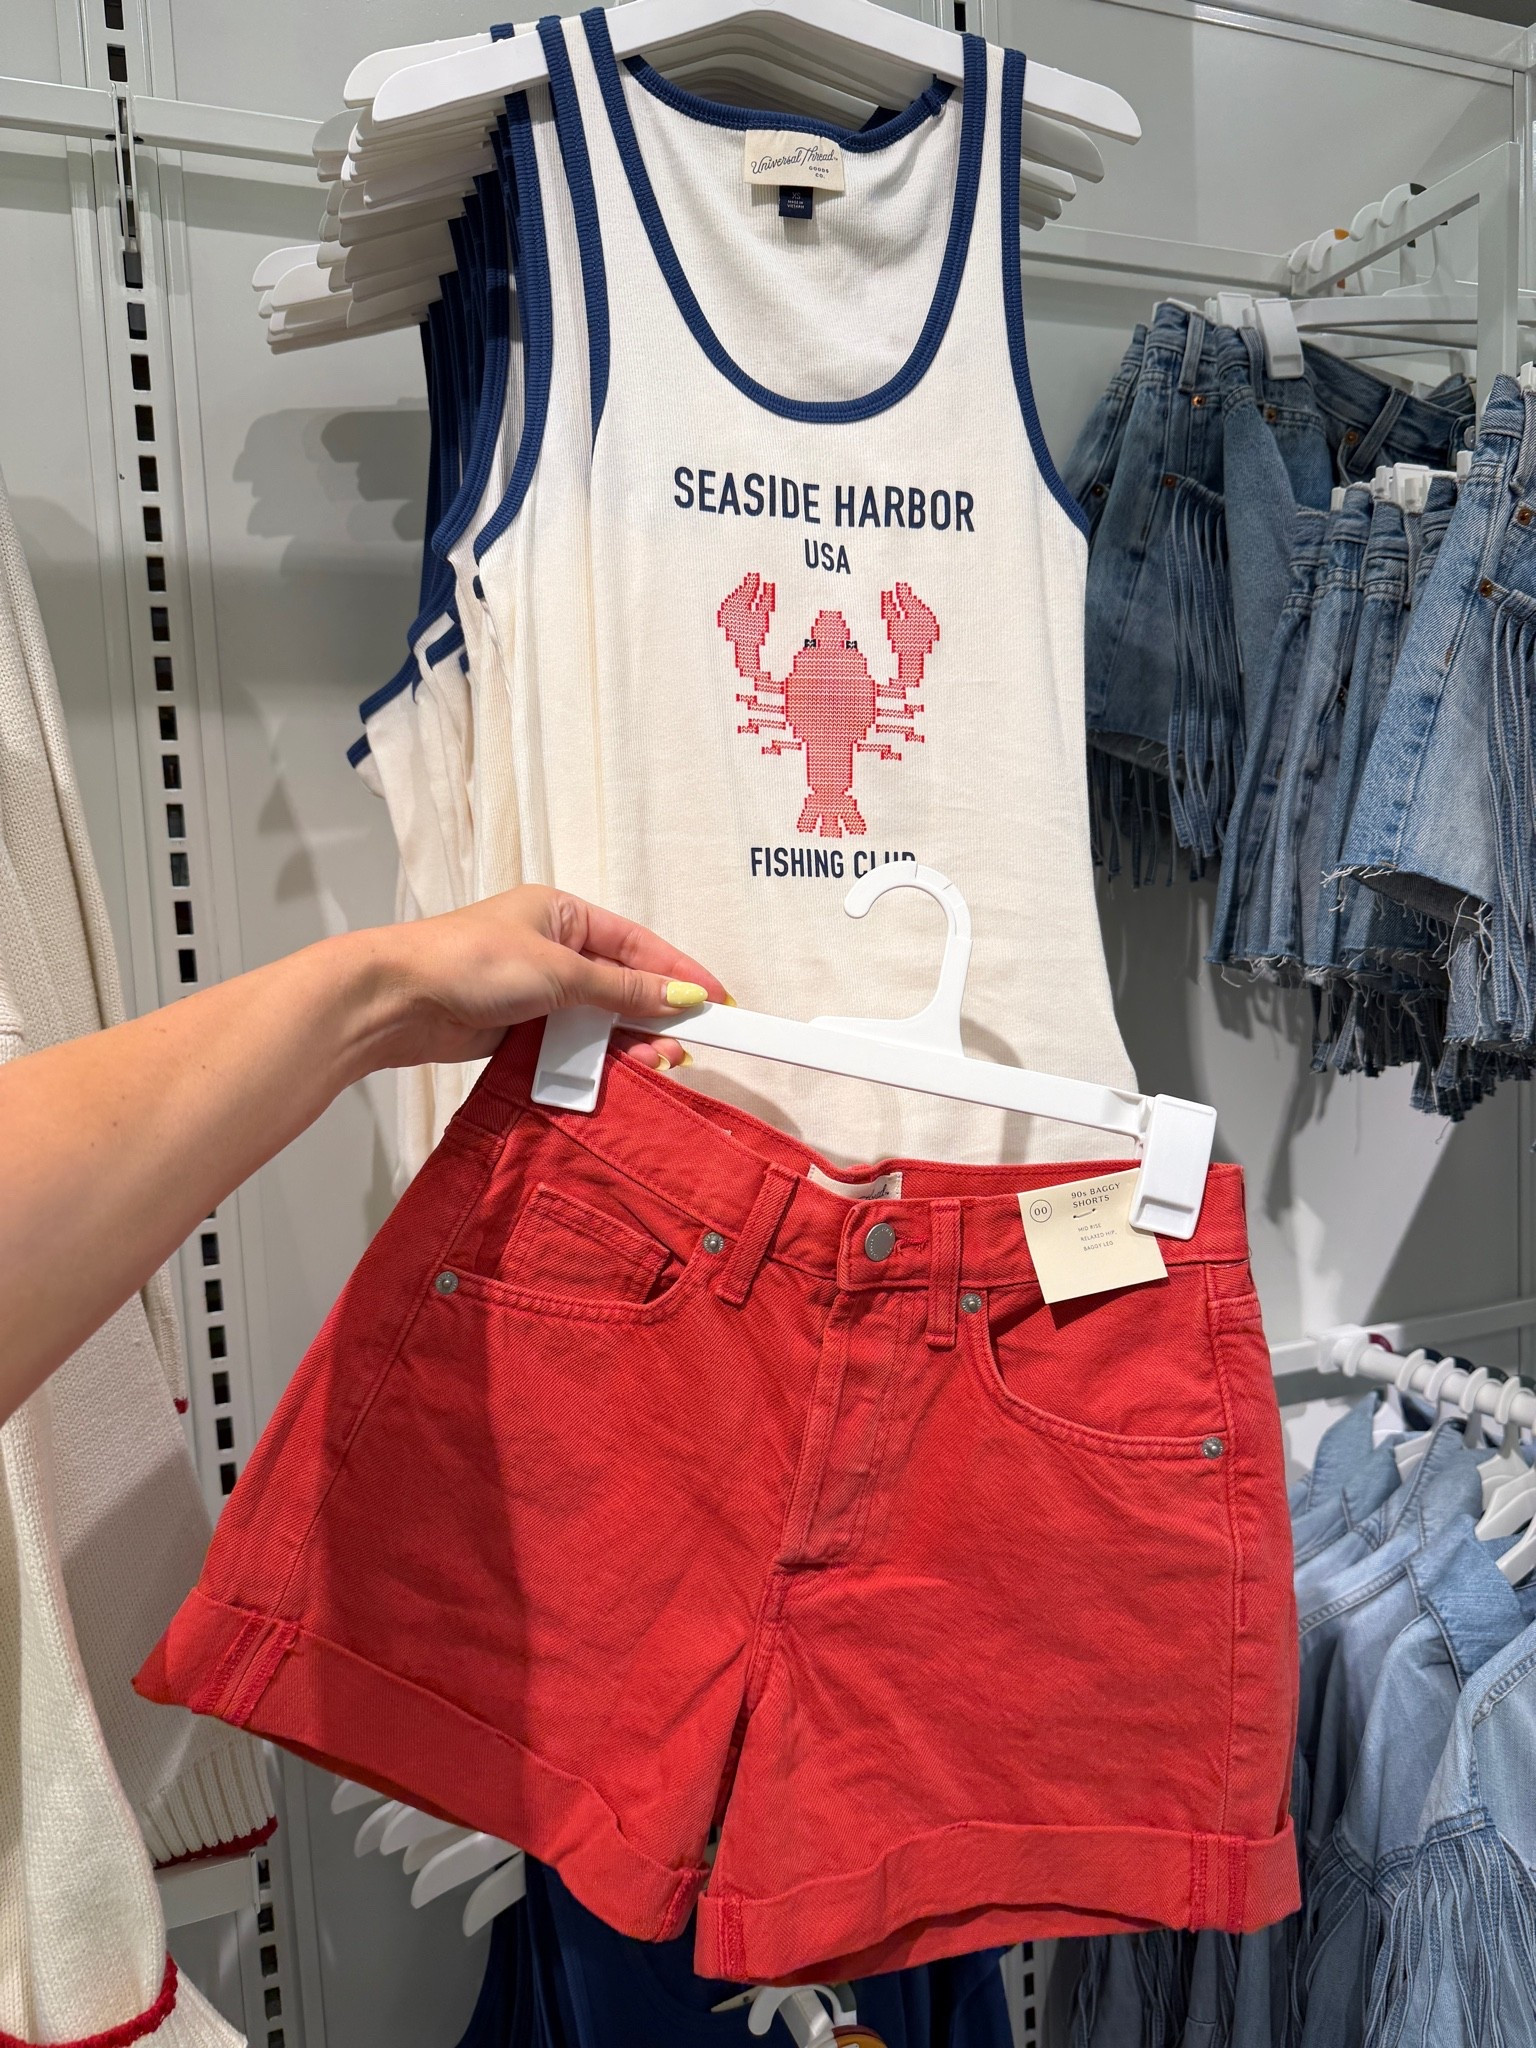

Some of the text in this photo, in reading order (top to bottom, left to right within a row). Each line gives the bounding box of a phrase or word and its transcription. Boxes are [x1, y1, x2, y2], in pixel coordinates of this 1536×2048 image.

[751, 145, 834, 174] Universal Thread
[808, 165, 829, 173] GOODS
[674, 466, 975, 532] SEASIDE HARBOR
[804, 539, 851, 574] USA
[751, 847, 844, 878] FISHING
[1071, 1182, 1121, 1199] 90s BAGGY
[1072, 1195, 1110, 1208] SHORTS
[1034, 1206, 1048, 1216] 00
[1080, 1232, 1104, 1241] RELAXED
[1083, 1242, 1102, 1251] BAGGY
